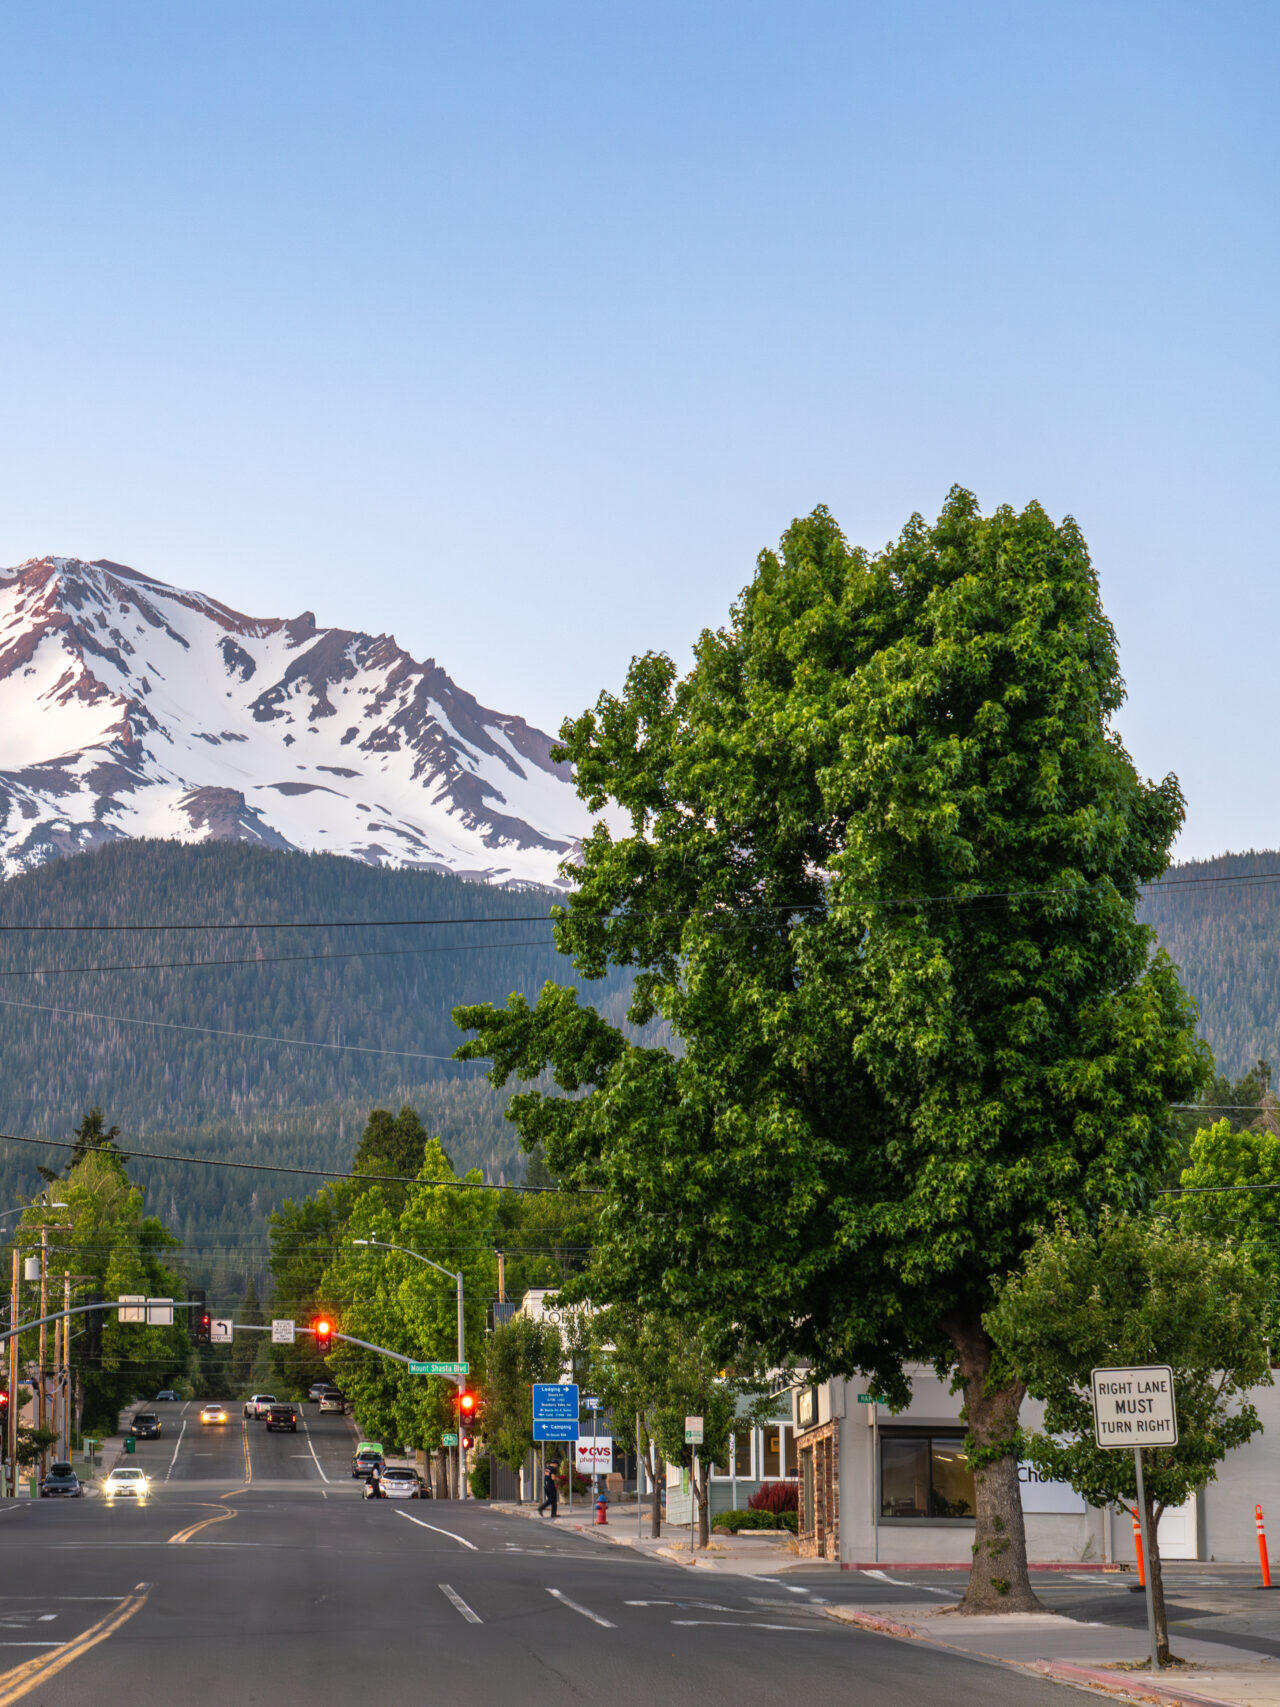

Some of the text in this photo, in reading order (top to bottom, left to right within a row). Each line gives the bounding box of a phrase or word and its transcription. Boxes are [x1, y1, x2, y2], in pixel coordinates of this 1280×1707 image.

[1099, 1381, 1168, 1395] RIGHT LANE
[1116, 1399, 1154, 1414] MUST
[1101, 1420, 1171, 1434] TURN RIGHT
[588, 1447, 611, 1456] CVS
